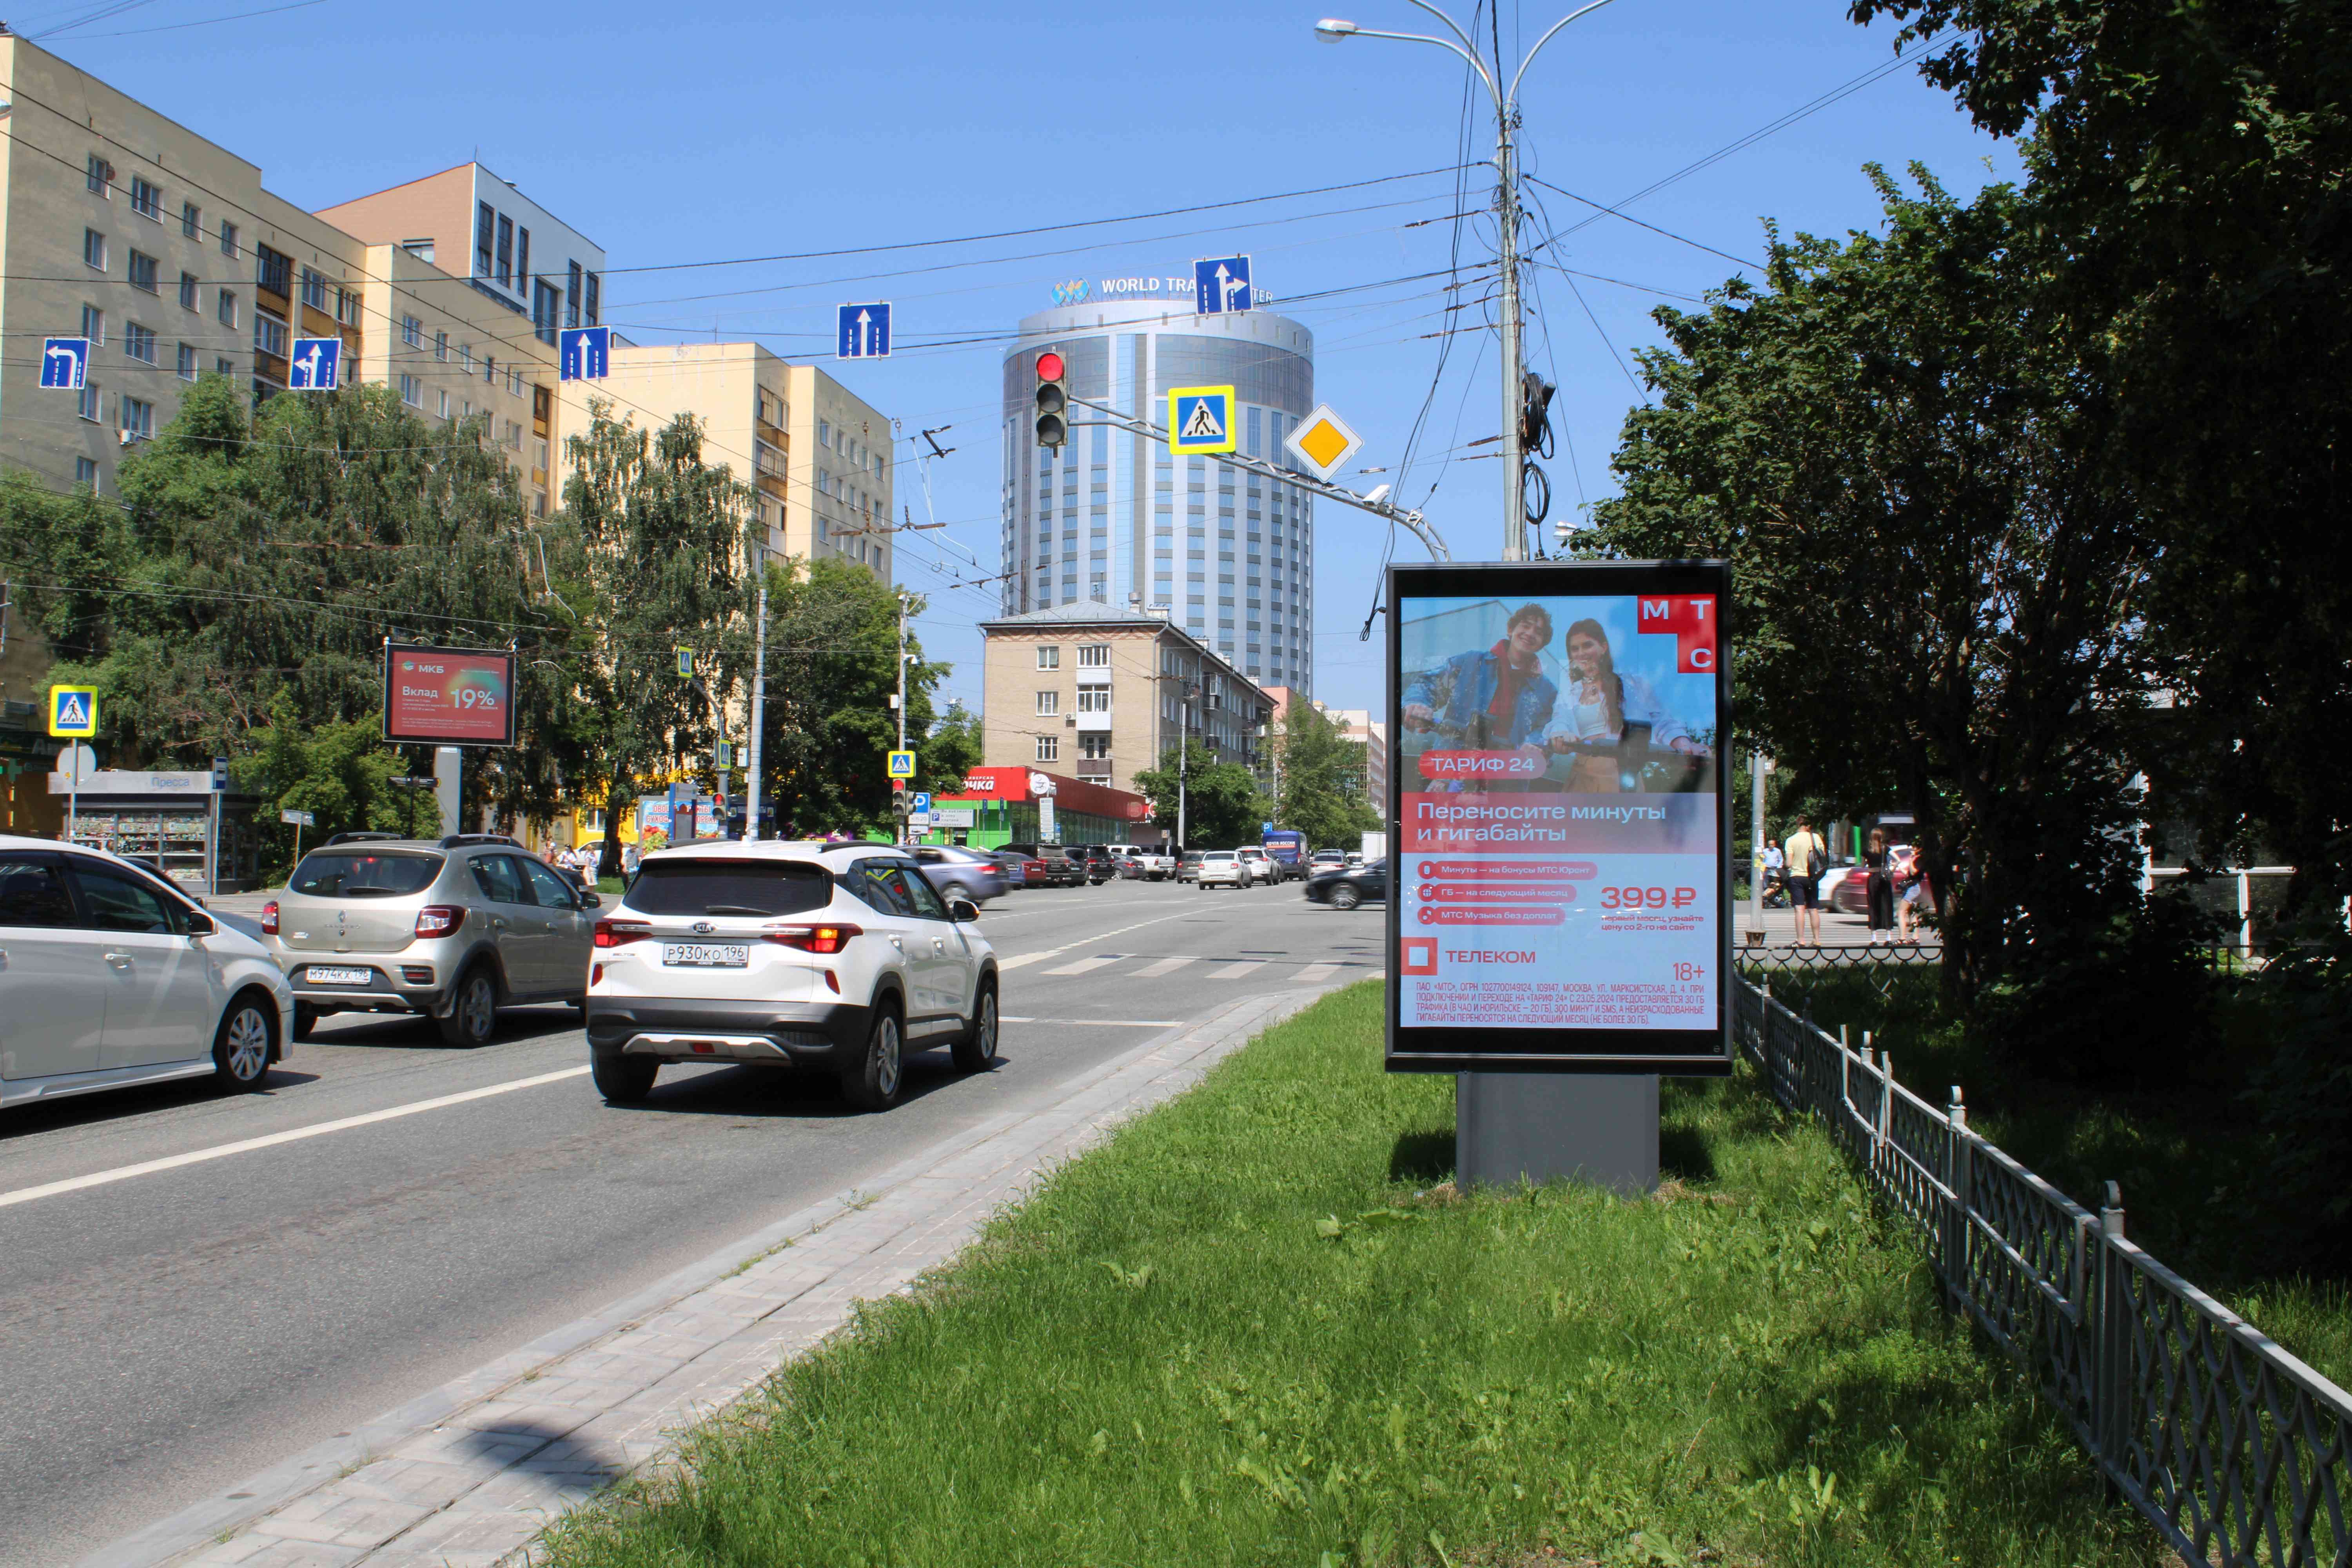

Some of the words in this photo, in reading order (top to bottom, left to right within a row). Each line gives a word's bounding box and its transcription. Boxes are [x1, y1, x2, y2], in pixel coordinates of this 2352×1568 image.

[1102, 278, 1160, 293] WORLD
[1166, 278, 1196, 292] TRA
[1251, 288, 1273, 304] TER
[419, 665, 445, 673] МКБ
[402, 686, 438, 698] Вклад
[451, 688, 495, 708] 19%
[1431, 758, 1504, 773] ТАРИФ
[1509, 758, 1535, 772] 24
[152, 777, 189, 788] Пресса
[1417, 802, 1565, 822] Переносите
[1572, 807, 1666, 824] минуты
[1417, 828, 1432, 841] и
[1438, 824, 1566, 842] гигабайты
[1441, 866, 1478, 875] Минуты
[1502, 866, 1536, 875] бонусы
[1479, 889, 1536, 898] следующий
[1601, 887, 1667, 909] 399
[1465, 912, 1503, 921] Музыка
[696, 924, 712, 932] KIA
[724, 946, 744, 957] 196
[1446, 951, 1536, 964] ТЕЛЕКОМ
[354, 969, 369, 977] 196
[1673, 962, 1705, 981] 18+
[1417, 982, 1430, 990] ПАО
[1461, 982, 1478, 991] ОГРН
[1690, 985, 1704, 993] ПРИ
[1417, 993, 1469, 1002] ПОДКЛЮЧЕНИИ
[1478, 993, 1513, 1002] ПЕРЕХОДЕ
[1569, 994, 1575, 1003] С
[1576, 995, 1614, 1003] 23.05.2024
[1616, 995, 1683, 1004] ПРЕДОСТАВЛЯЕТСЯ
[1685, 995, 1694, 1004] 30
[1696, 995, 1705, 1004] ГБ
[1416, 1003, 1448, 1012] ТРАФИКА
[1450, 1003, 1456, 1013] (В
[1459, 1003, 1472, 1012] ЧАО
[1474, 1004, 1479, 1012] И
[1480, 1004, 1521, 1012] НОРИЛЬСКЕ
[1530, 1004, 1539, 1013] 20
[1555, 1004, 1568, 1013] 300
[1570, 1004, 1593, 1013] МИНУТ
[1595, 1005, 1600, 1013] И
[1619, 1005, 1624, 1013] А
[1625, 1005, 1704, 1014] НЕИЗРАСХОДОВАННЫЕ
[1416, 1011, 1455, 1022] ГИГАБАЙТЫ
[1457, 1013, 1506, 1022] ПЕРЕНОСЯТСЯ
[1507, 1014, 1516, 1022] НА
[1517, 1013, 1563, 1024] СЛЕДУЮЩИЙ
[1565, 1014, 1589, 1024] МЕСЯЦ
[1590, 1014, 1601, 1025] (НЕ
[1603, 1015, 1625, 1024] БОЛЕЕ
[1627, 1015, 1636, 1024] 30
